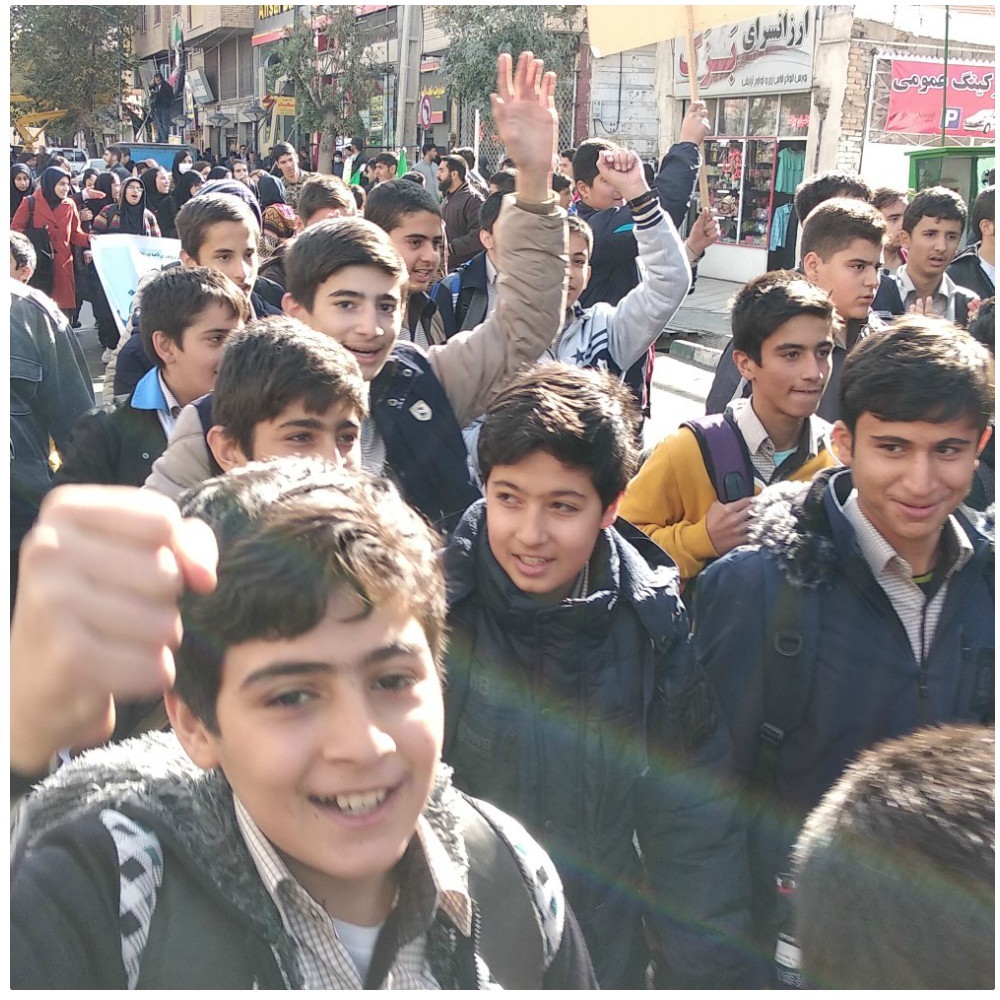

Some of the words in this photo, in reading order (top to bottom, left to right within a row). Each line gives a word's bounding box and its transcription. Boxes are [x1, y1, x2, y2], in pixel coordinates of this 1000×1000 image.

[893, 73, 946, 94] عمومی
[952, 70, 995, 98] کینگ
[945, 109, 958, 127] P
